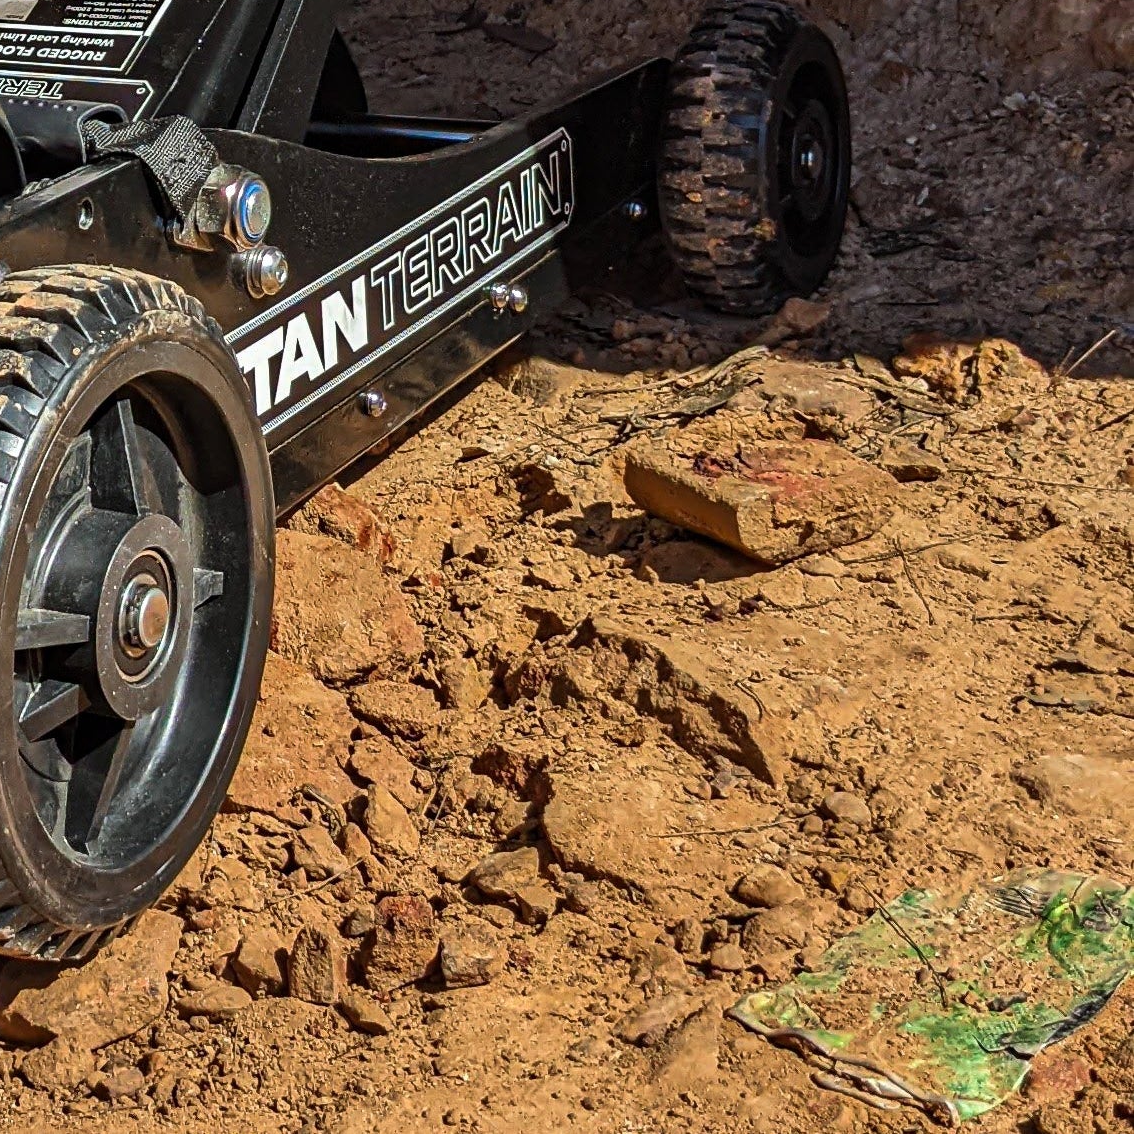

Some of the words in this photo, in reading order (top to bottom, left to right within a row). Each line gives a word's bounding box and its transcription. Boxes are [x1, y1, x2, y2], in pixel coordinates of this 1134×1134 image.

[29, 34, 59, 43] Load
[63, 35, 114, 47] Working
[36, 47, 106, 61] RUGGED
[235, 274, 369, 416] TAN
[371, 151, 562, 332] TERRAIN
